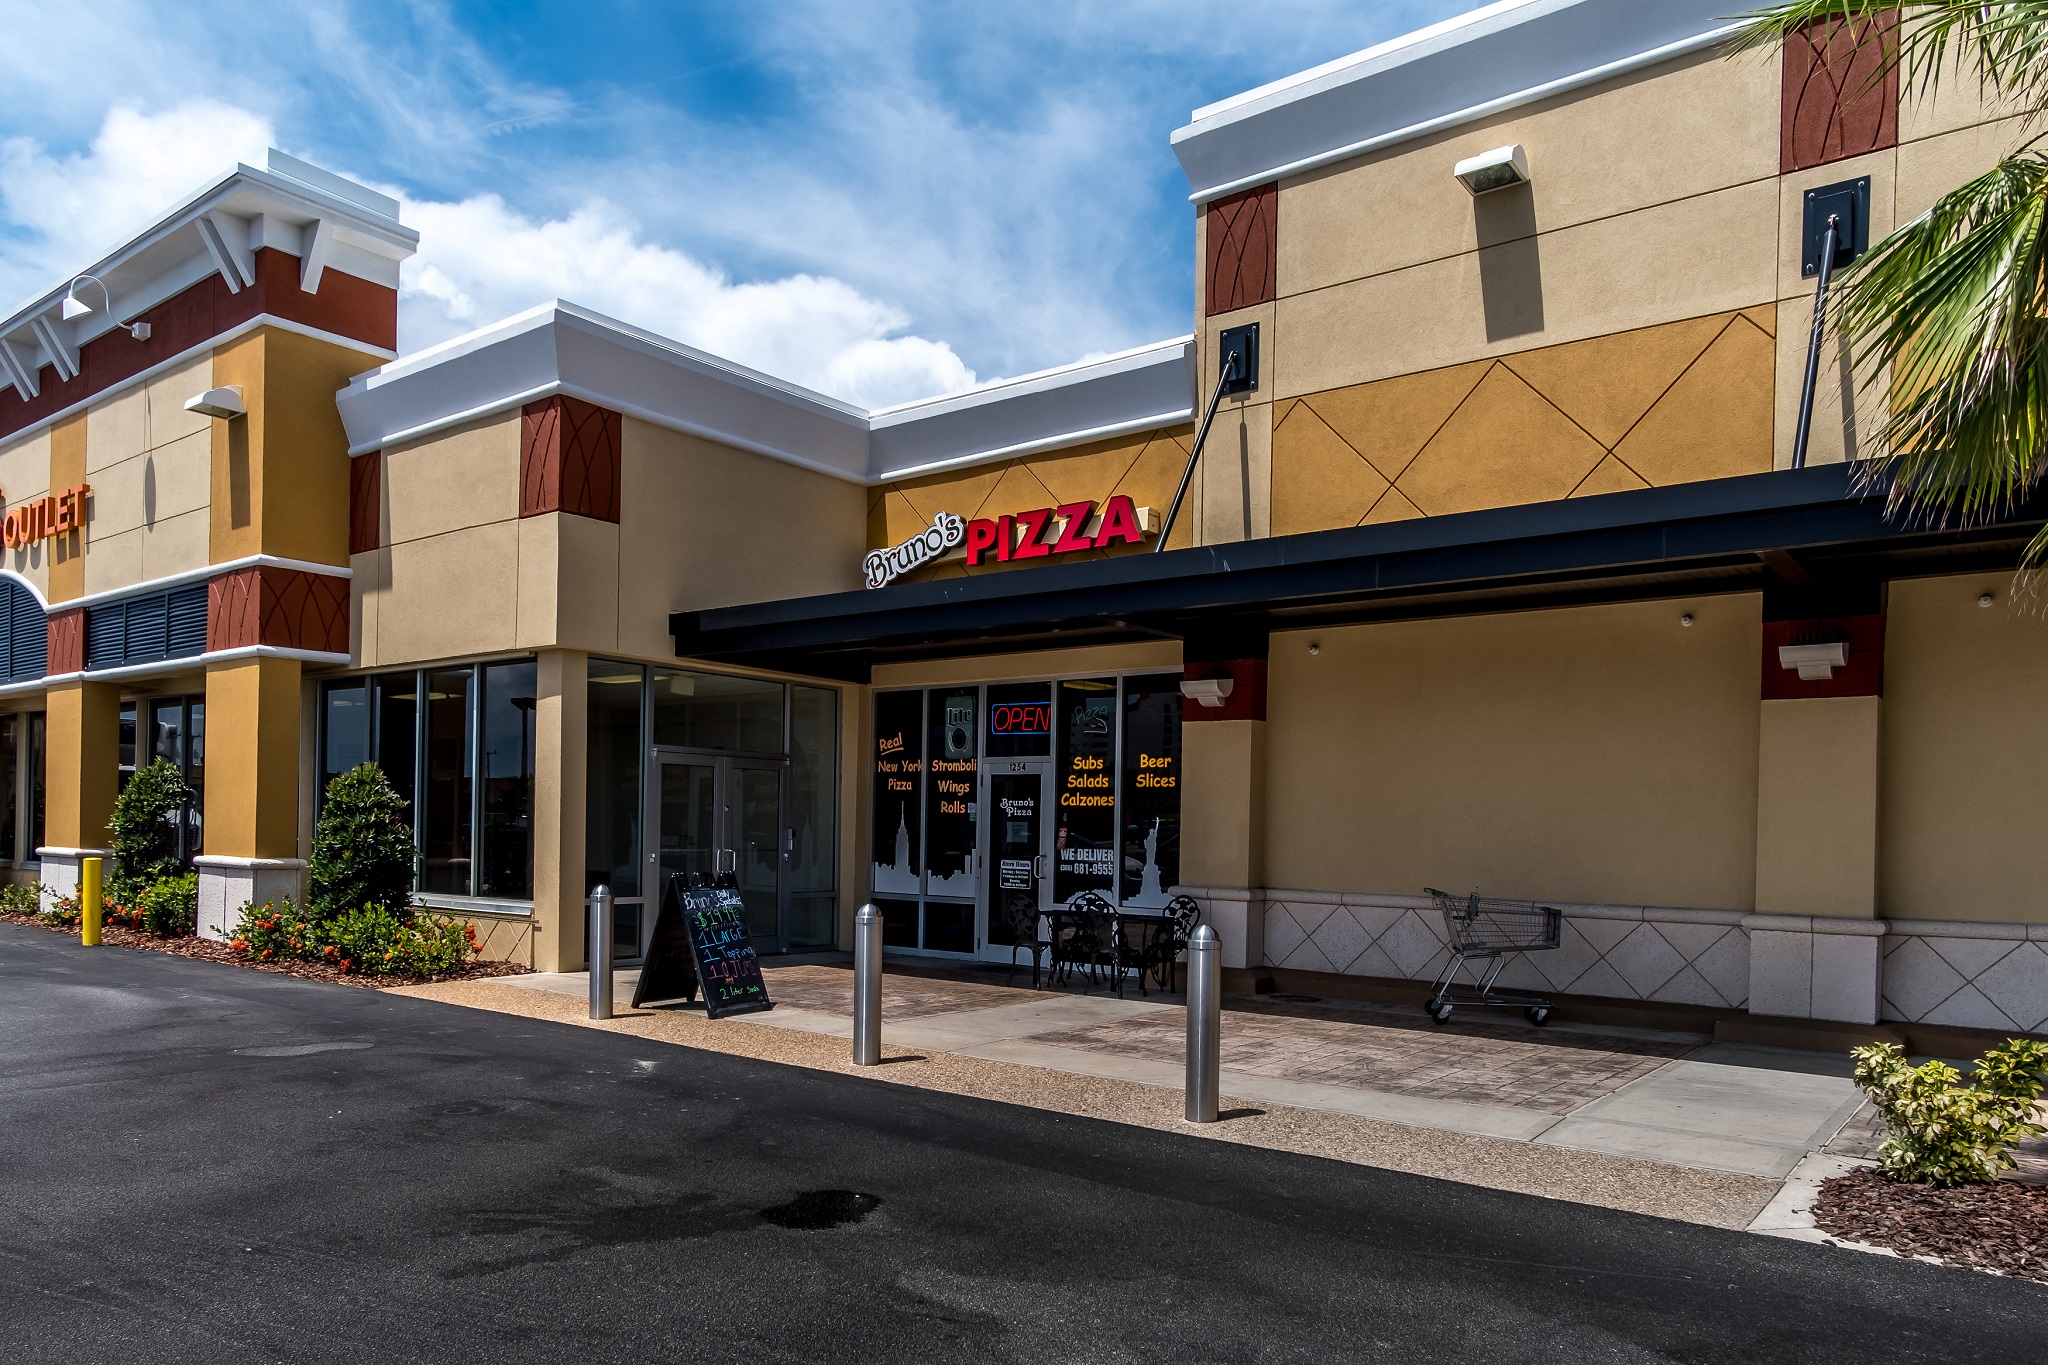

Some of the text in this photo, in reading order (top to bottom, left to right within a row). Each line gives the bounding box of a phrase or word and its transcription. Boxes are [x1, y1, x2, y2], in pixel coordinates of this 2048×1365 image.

[4, 484, 90, 549] OUTLET
[863, 495, 1146, 589] Bruno's PIZZA
[946, 707, 972, 728] Lite
[994, 707, 1051, 731] OPEN
[879, 732, 903, 752] Real
[878, 759, 923, 772] New York
[931, 758, 977, 772] Stromboli
[1009, 762, 1026, 772] 1254
[1073, 755, 1104, 770] Subs
[1140, 753, 1172, 768] Beer
[888, 778, 912, 791] Pizza
[938, 780, 970, 796] Wings
[1067, 773, 1109, 788] Salads
[1135, 773, 1176, 788] Slices
[940, 800, 966, 813] Rolls
[1000, 797, 1034, 808] Bruno's
[1061, 792, 1115, 806] Calzones
[1006, 806, 1032, 817] Pizza
[1060, 848, 1114, 861] WE DELIVER
[1074, 862, 1114, 875] 681-9555
[699, 931, 715, 948] 1
[704, 945, 757, 962] 1 Topping
[720, 988, 730, 999] 2
